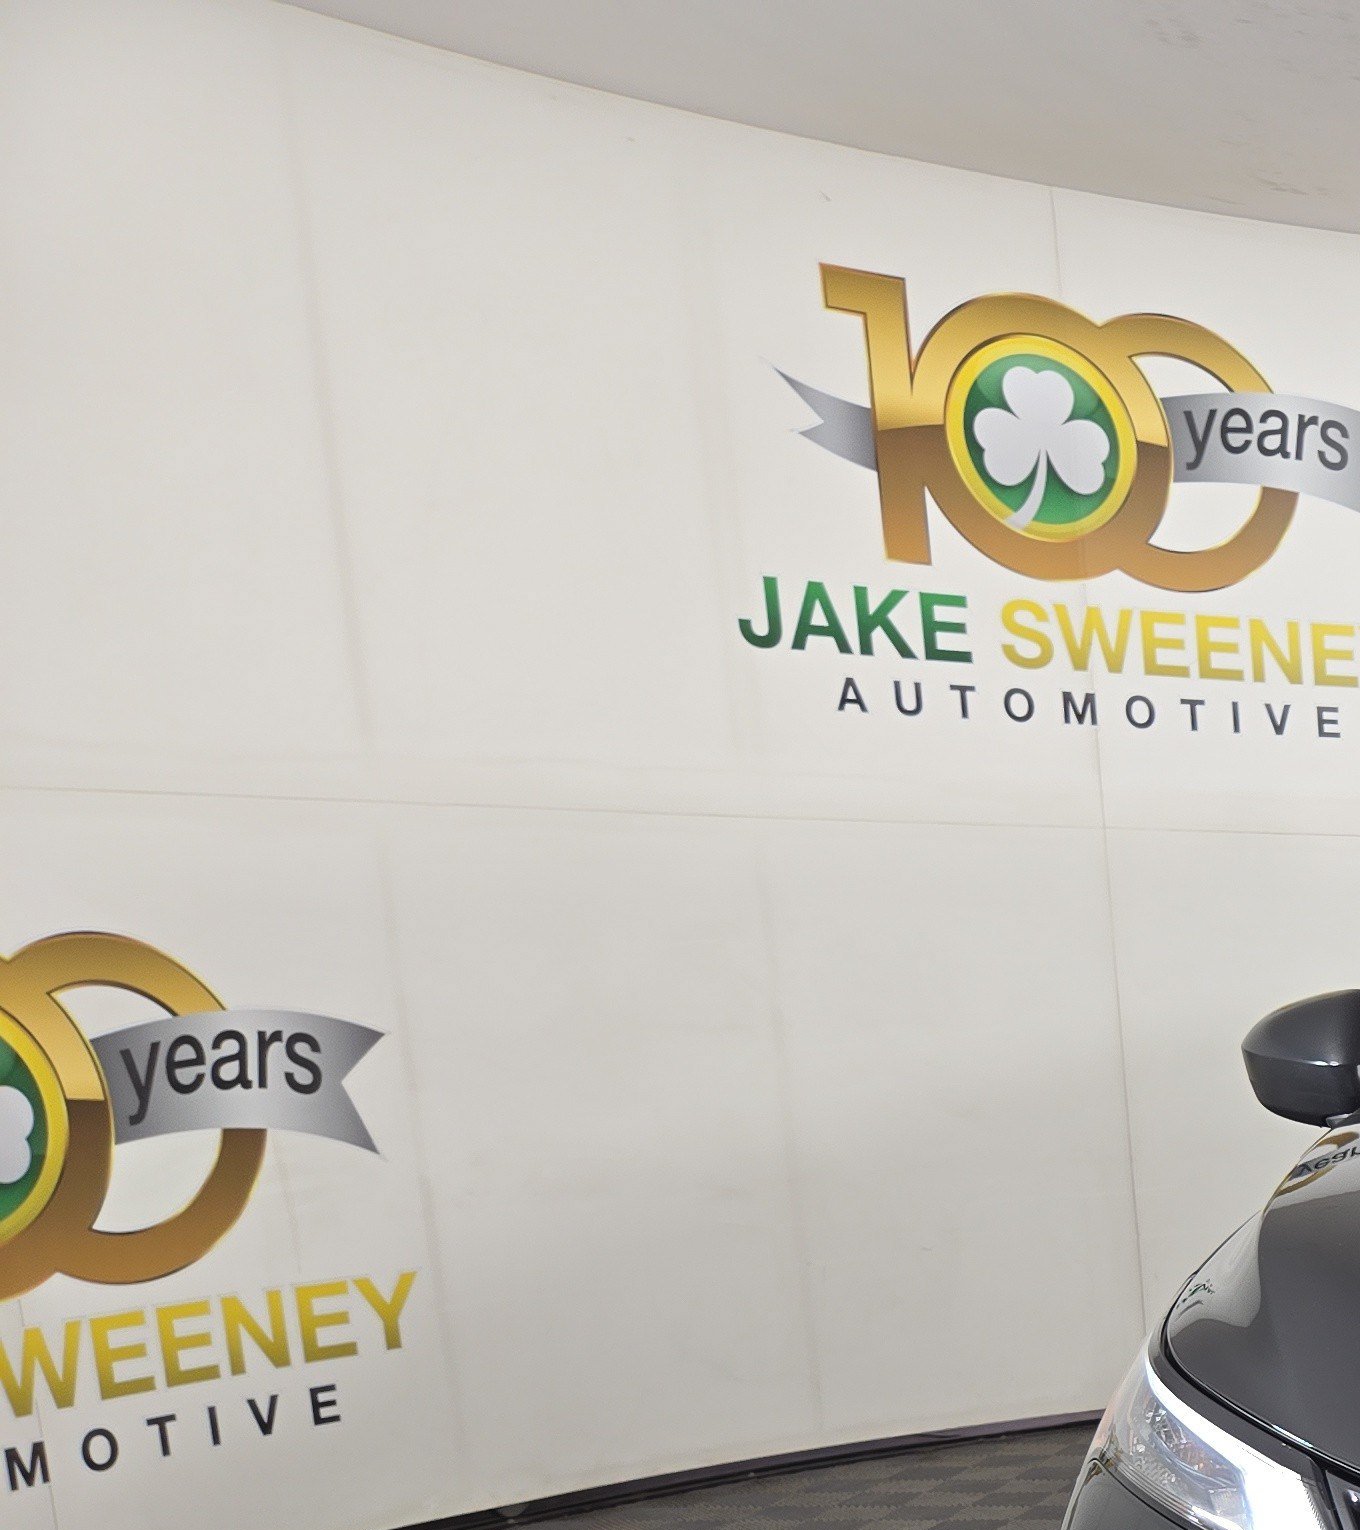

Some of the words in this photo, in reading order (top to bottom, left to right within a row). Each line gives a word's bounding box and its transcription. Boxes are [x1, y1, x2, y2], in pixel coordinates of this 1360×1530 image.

[1182, 406, 1350, 472] years
[738, 575, 974, 665] JAKE
[837, 676, 1342, 738] AUTOMOTIVE
[119, 1028, 324, 1127] years
[4, 1384, 342, 1491] MOTIVE
